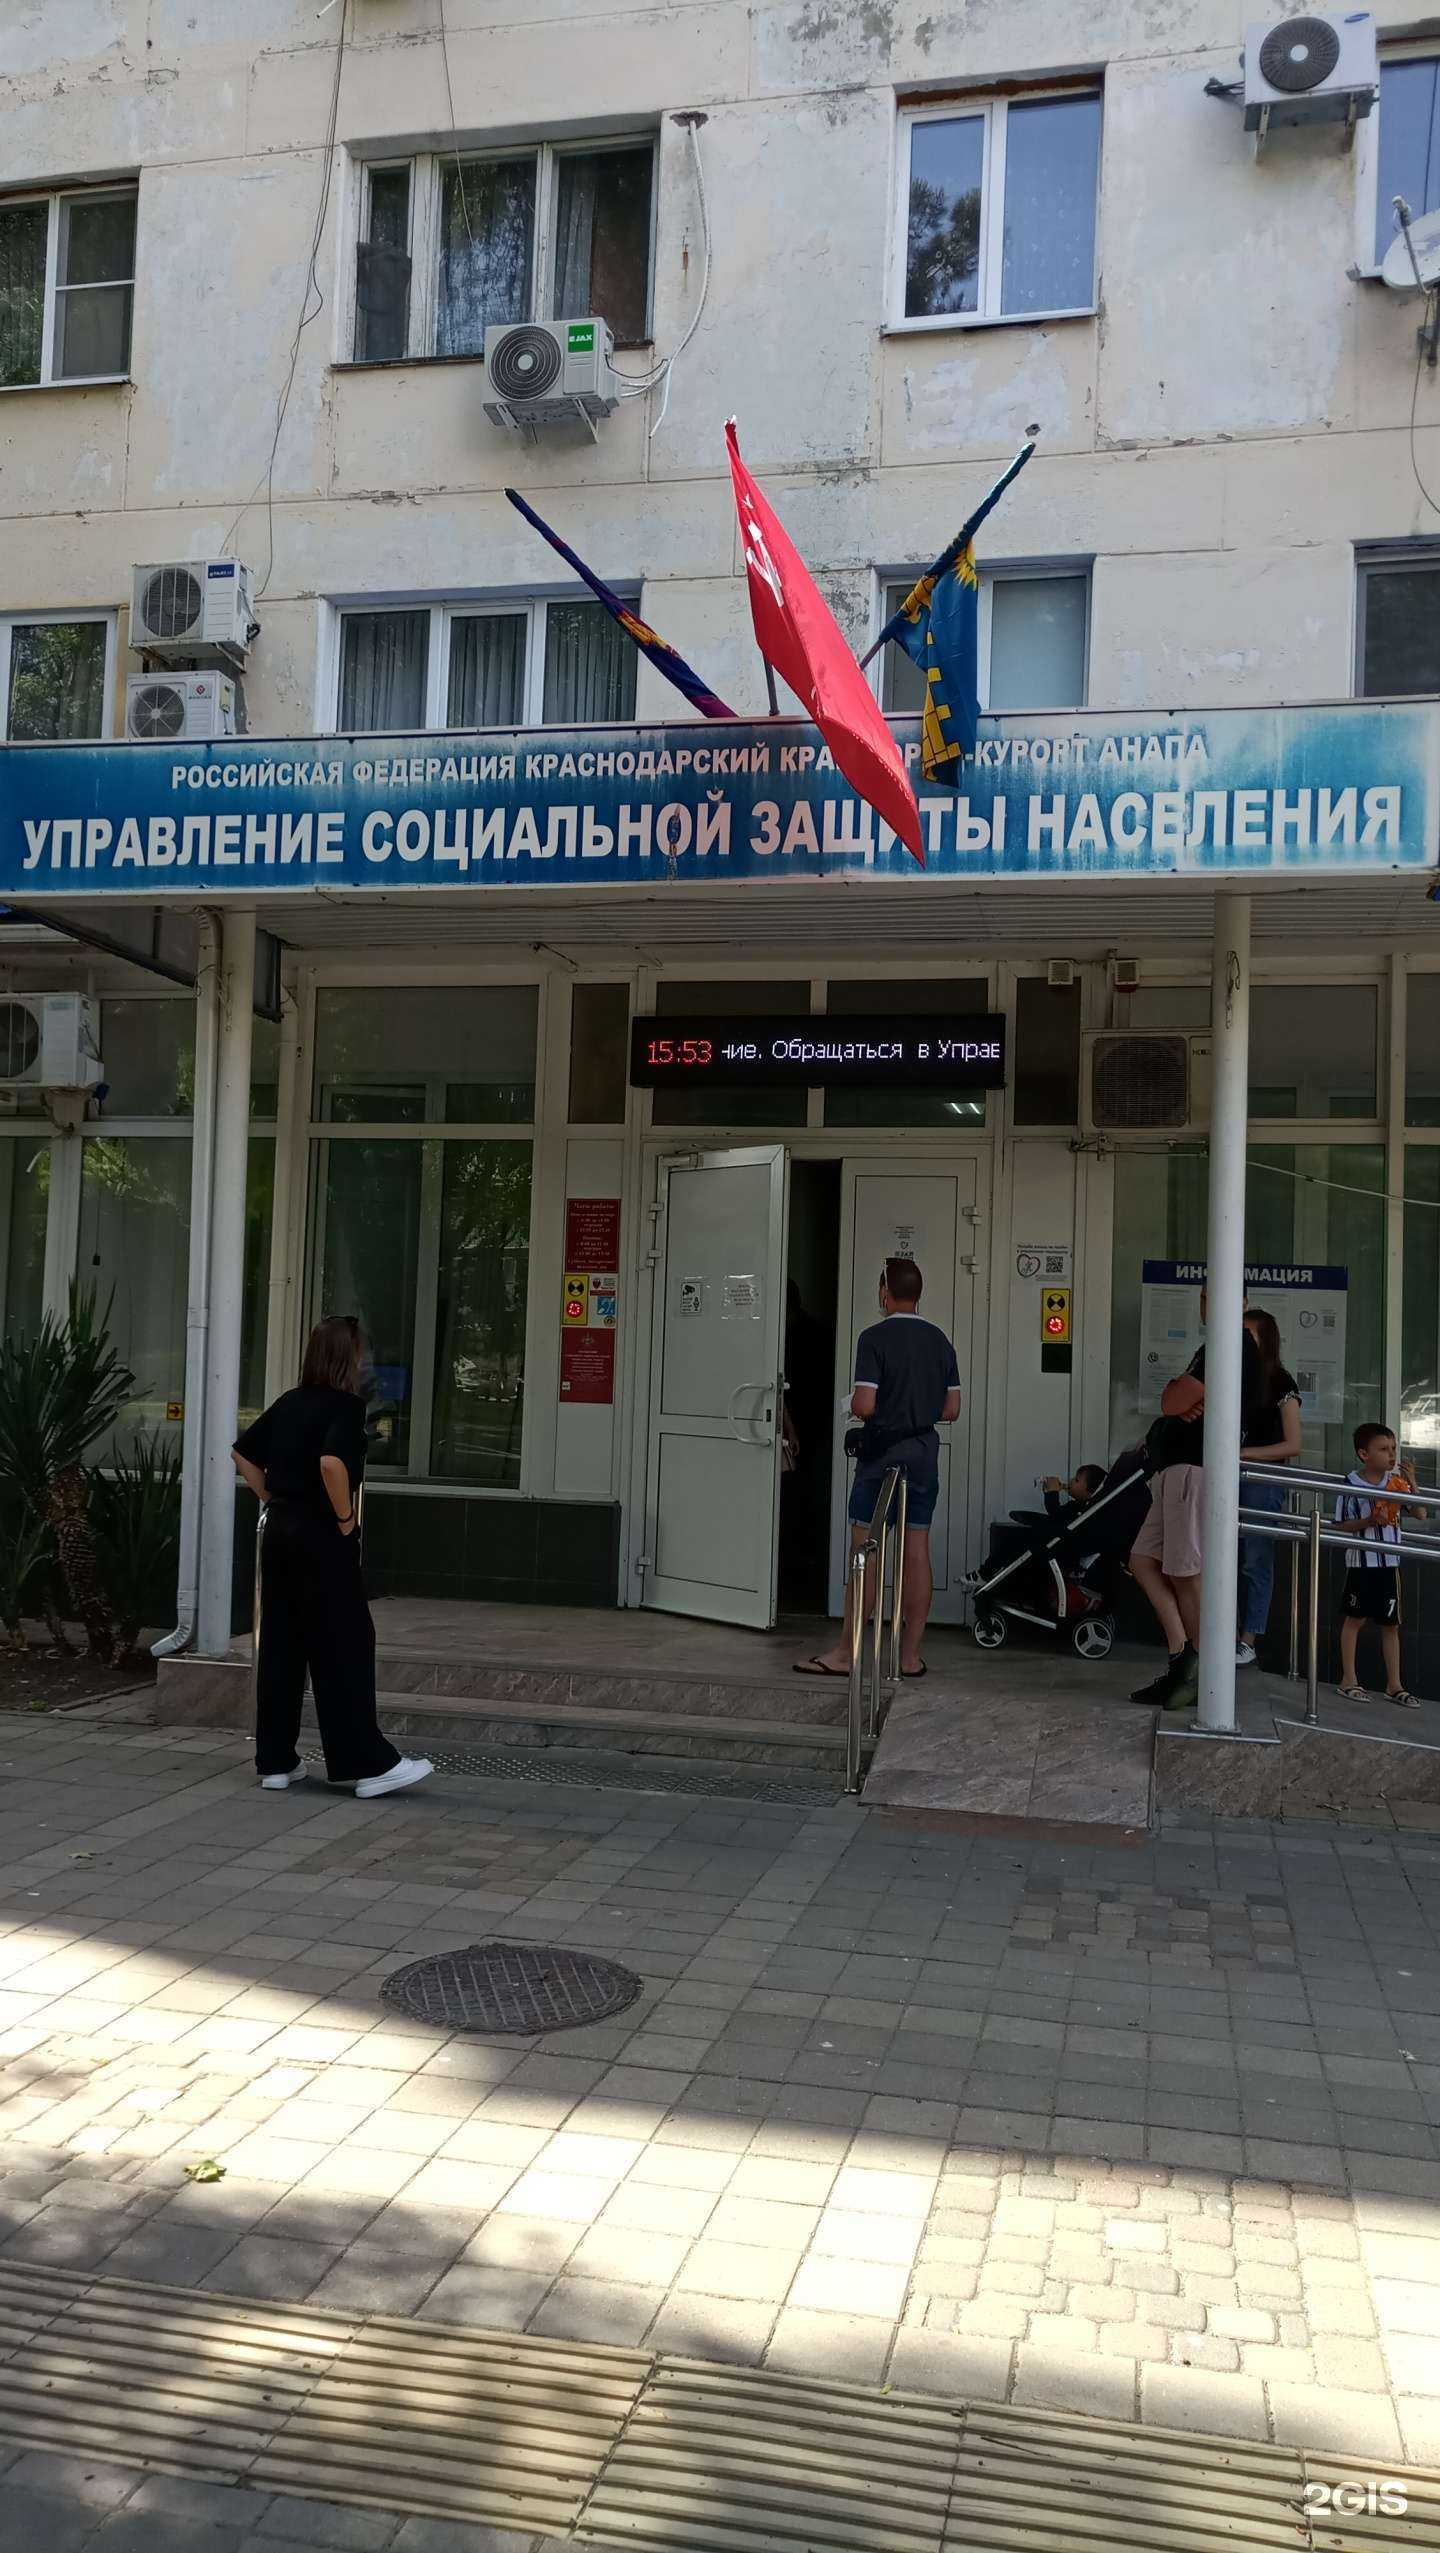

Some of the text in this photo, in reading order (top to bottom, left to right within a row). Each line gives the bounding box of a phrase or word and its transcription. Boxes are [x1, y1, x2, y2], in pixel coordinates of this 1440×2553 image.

[172, 758, 344, 789] РОССИЙСКАЯ
[352, 755, 516, 787] ФЕДЕРАЦИЯ
[525, 742, 770, 780] КРАСНОДАРСКИЙ
[780, 745, 840, 774] КРА
[1100, 734, 1209, 763] АНАПА
[22, 811, 345, 870] УПРАВЛЕНИЕ
[362, 787, 732, 870] СОЦИАЛЬНОЙ
[1028, 785, 1401, 852] НАСЕЛЕНИЯ
[647, 1040, 713, 1063] 15:53
[771, 1038, 903, 1063] Обращаться
[918, 1043, 930, 1059] в
[1175, 1264, 1313, 1285] ИНМАЦИЯ
